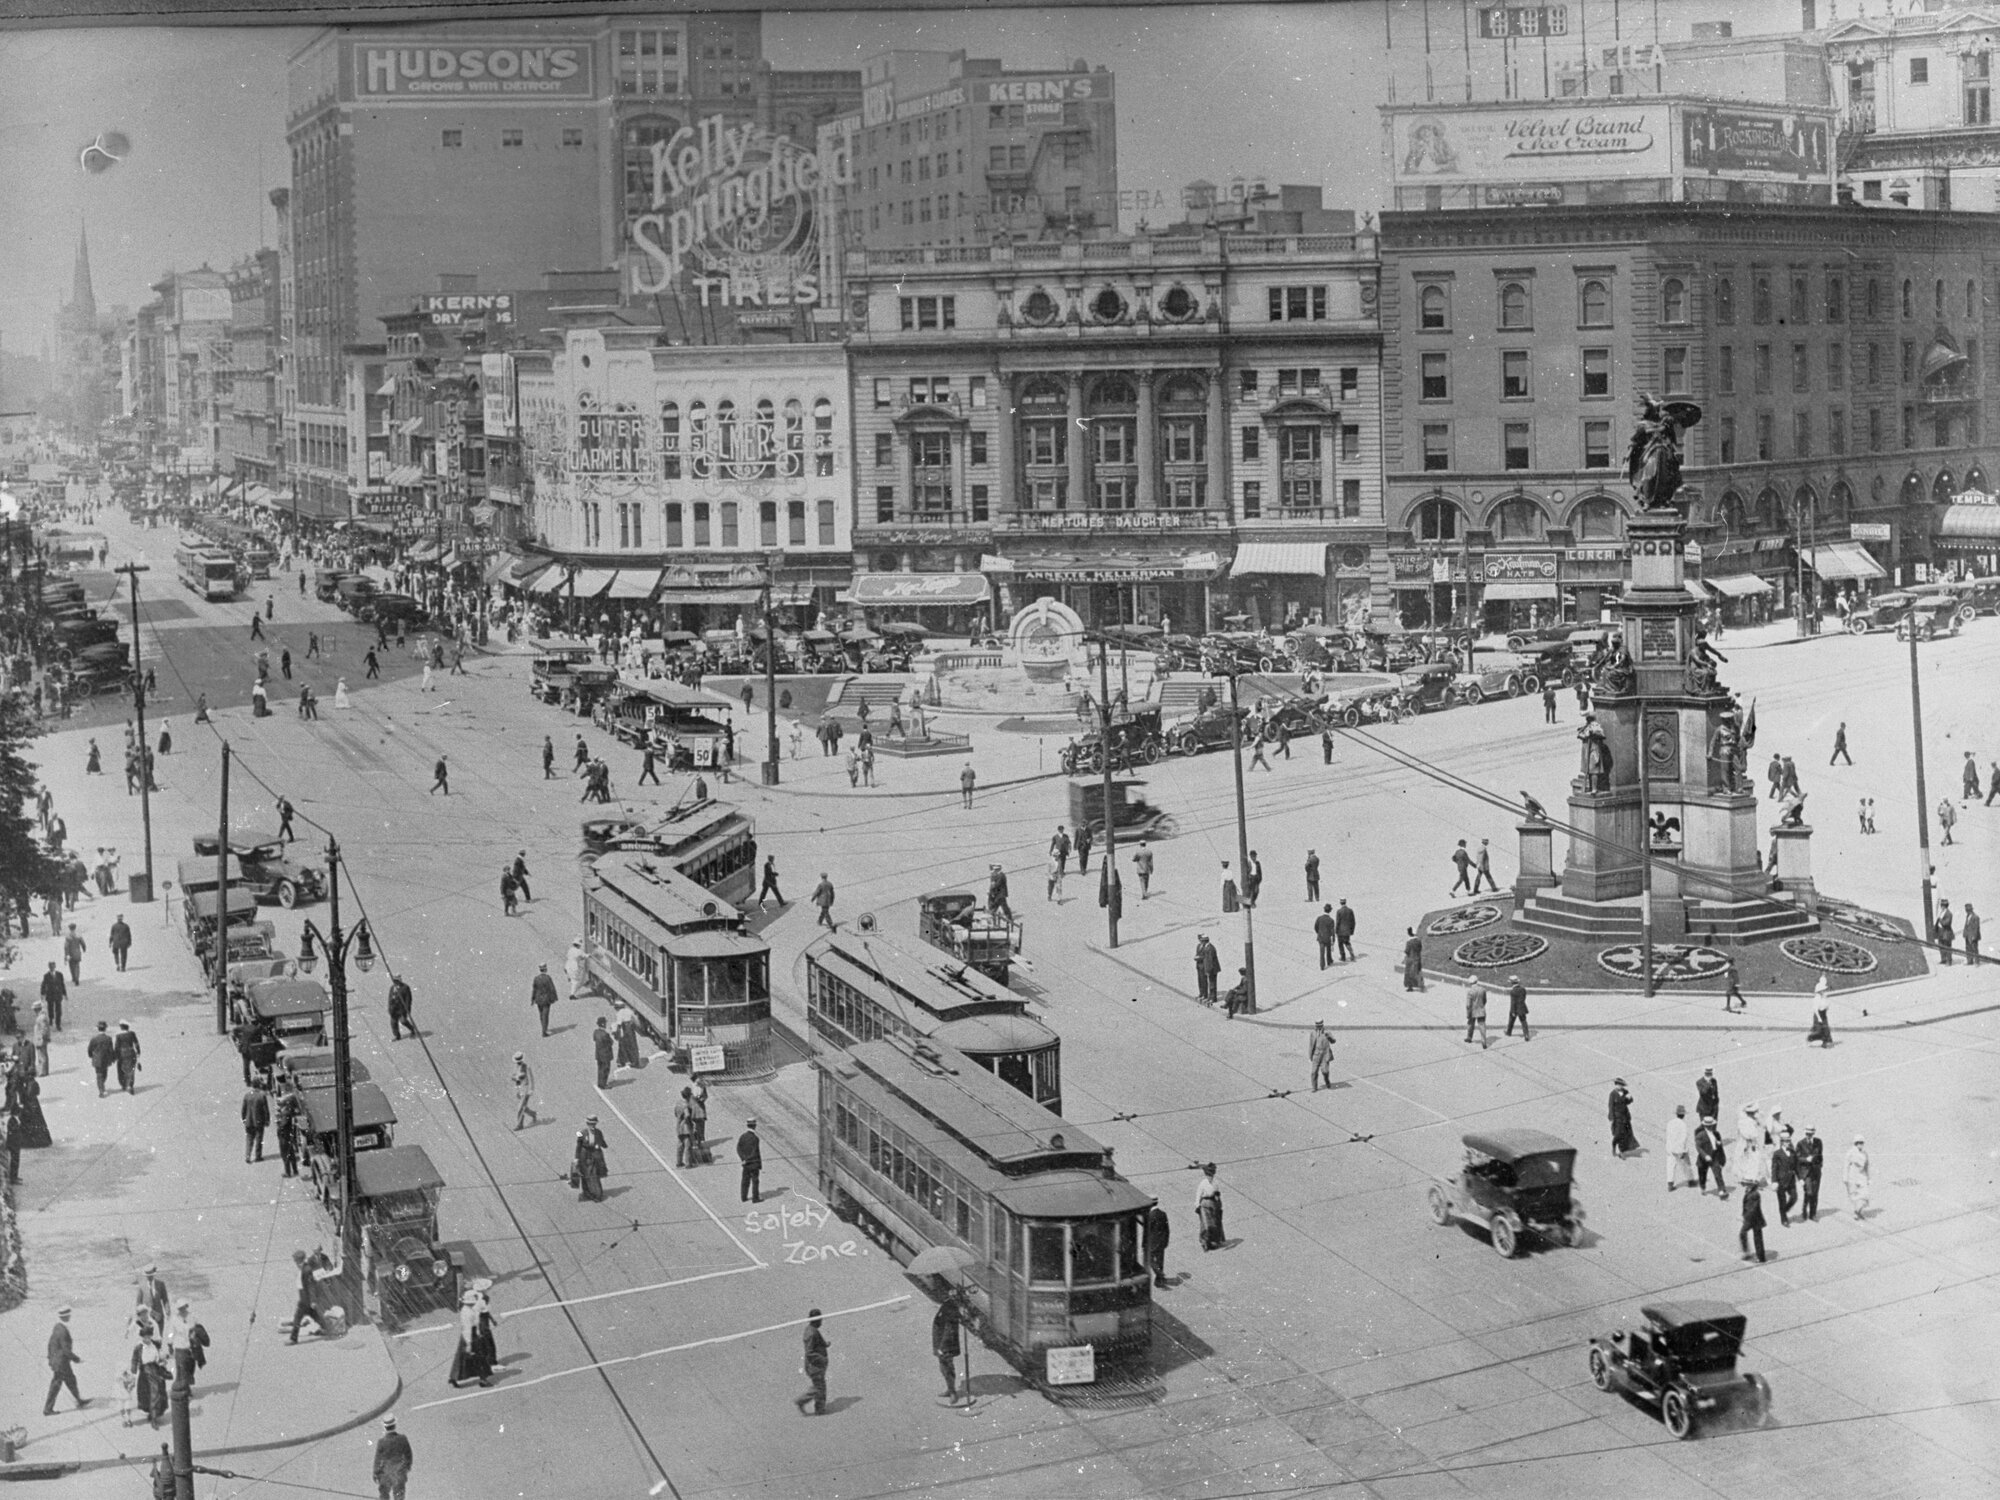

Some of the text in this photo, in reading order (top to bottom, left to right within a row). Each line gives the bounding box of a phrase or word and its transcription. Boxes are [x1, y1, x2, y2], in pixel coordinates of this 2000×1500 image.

[367, 49, 579, 91] HUDSON'S
[408, 81, 561, 91] GROWS WITH DETROIT
[989, 79, 1092, 101] KERN'S
[1504, 117, 1570, 138] Velvet
[1574, 115, 1645, 136] Brand
[1564, 136, 1628, 149] Cream
[652, 114, 755, 210] Kelly
[632, 134, 854, 295] Springfield
[692, 274, 819, 307] TIRES
[429, 295, 511, 310] KERN'S
[432, 312, 462, 324] DRY
[579, 419, 641, 438] OUTER
[1951, 495, 1996, 505] TEMPLE
[696, 749, 710, 762] 50
